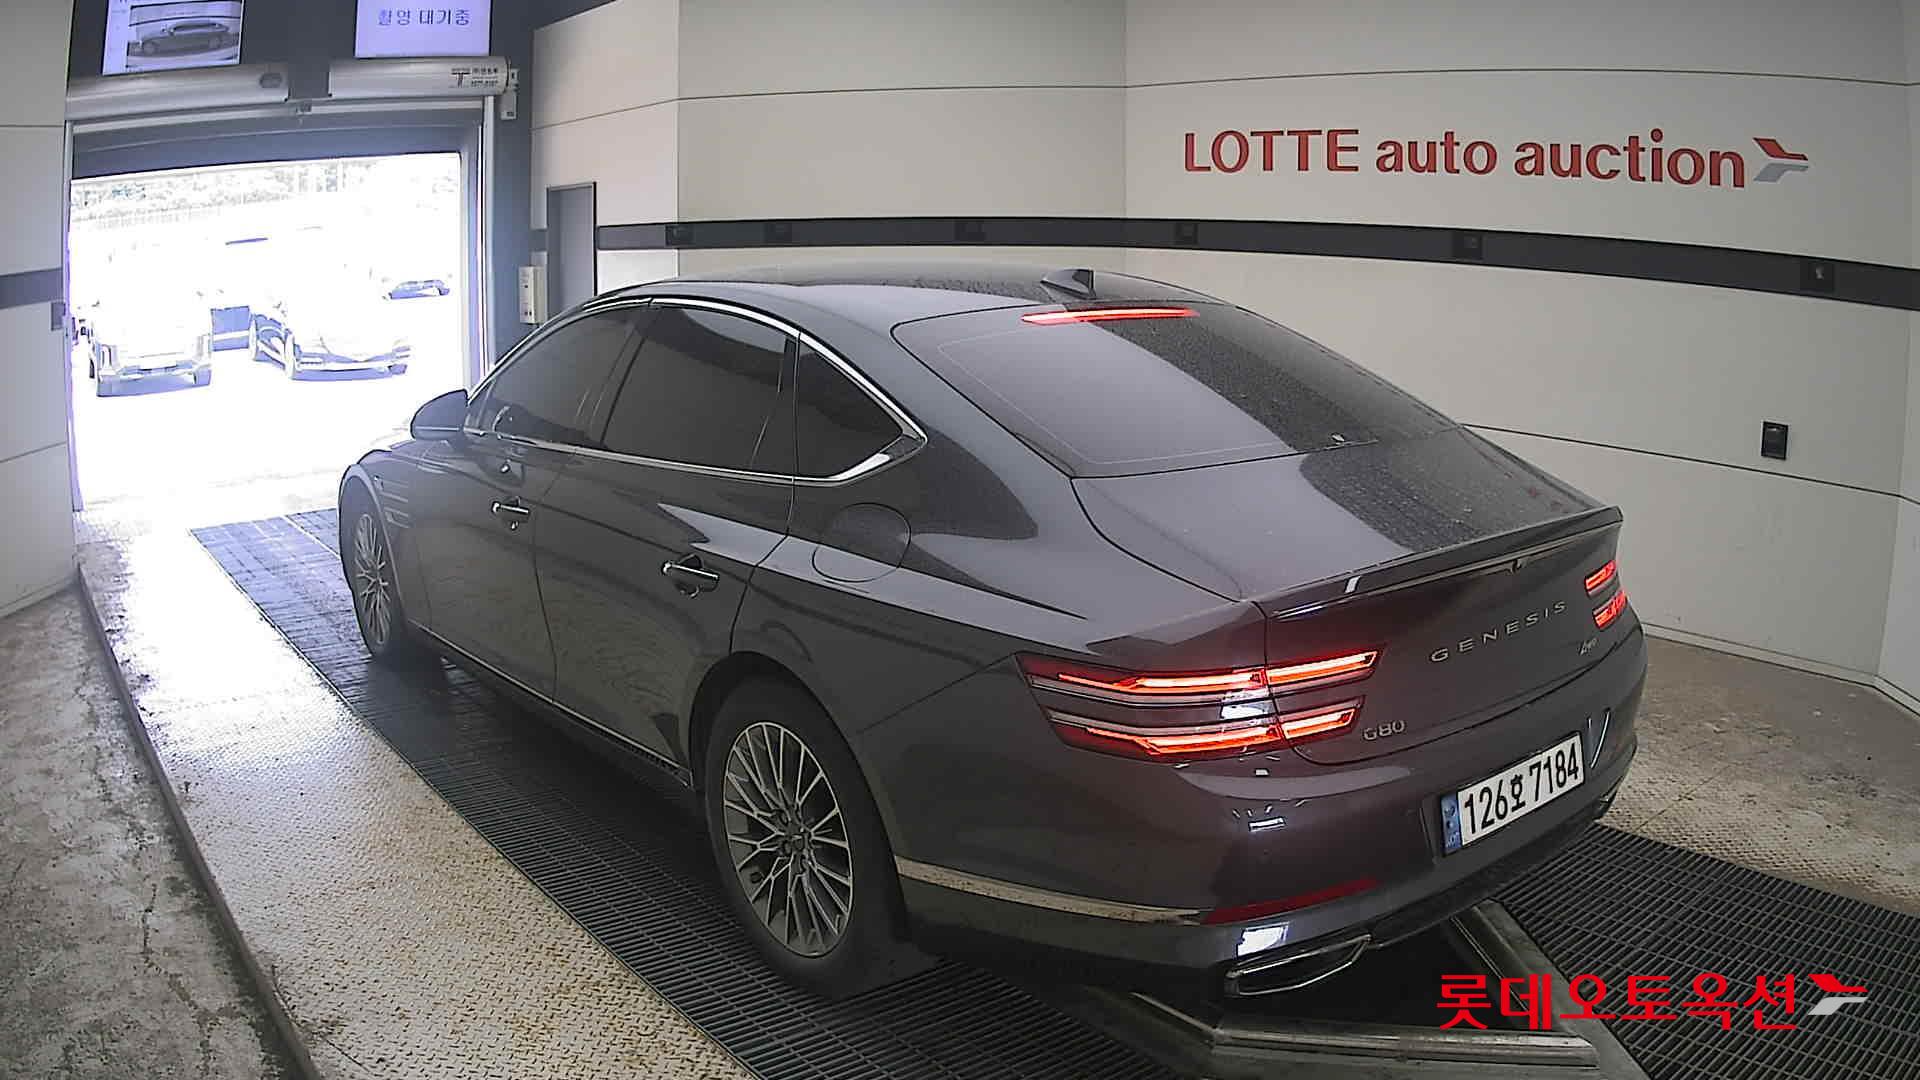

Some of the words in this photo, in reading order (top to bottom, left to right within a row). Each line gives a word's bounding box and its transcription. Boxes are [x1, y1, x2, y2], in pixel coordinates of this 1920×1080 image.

[418, 8, 471, 26] 대기중
[1184, 129, 1360, 173] LOTTE
[1375, 130, 1499, 175] auto
[1513, 128, 1746, 188] auction
[1430, 600, 1568, 663] GENESIS
[1362, 719, 1407, 742] G80
[1463, 773, 1527, 835] 126호
[1528, 741, 1580, 803] 7184
